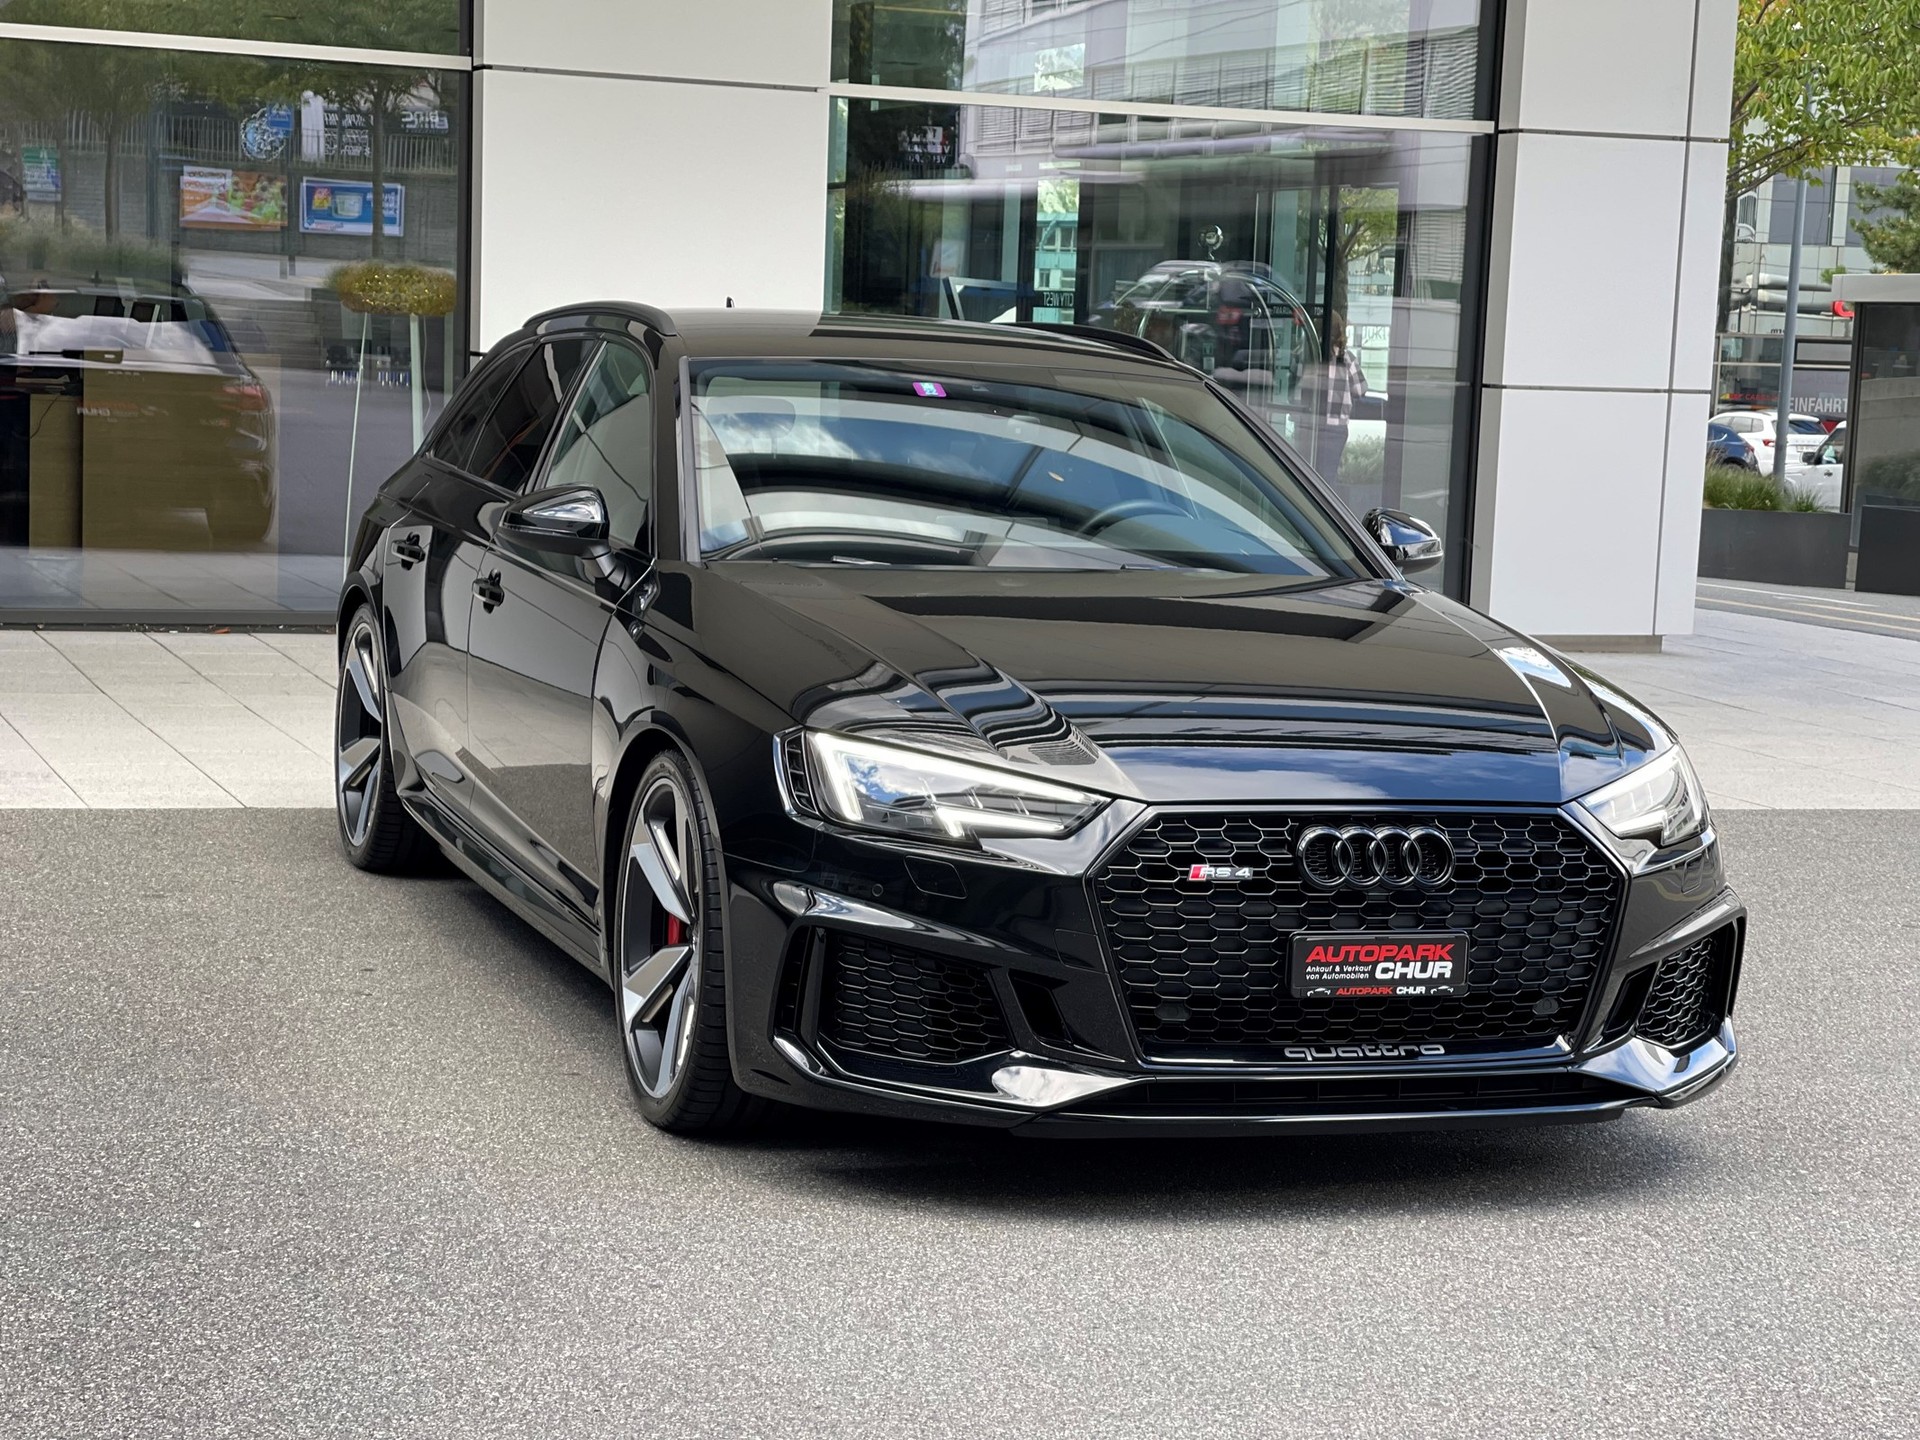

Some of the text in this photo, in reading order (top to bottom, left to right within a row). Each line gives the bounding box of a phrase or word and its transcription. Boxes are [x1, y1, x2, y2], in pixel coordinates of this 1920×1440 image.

[1789, 397, 1848, 413] EINFAHRT
[1305, 944, 1455, 963] AUTOPARK
[1305, 964, 1372, 973] Ankauf & Verkauf
[1322, 972, 1369, 980] Automobilen
[1375, 961, 1453, 980] CHUR
[1336, 986, 1426, 996] AUTOPARK CHUR
[1284, 1043, 1446, 1061] quattro
